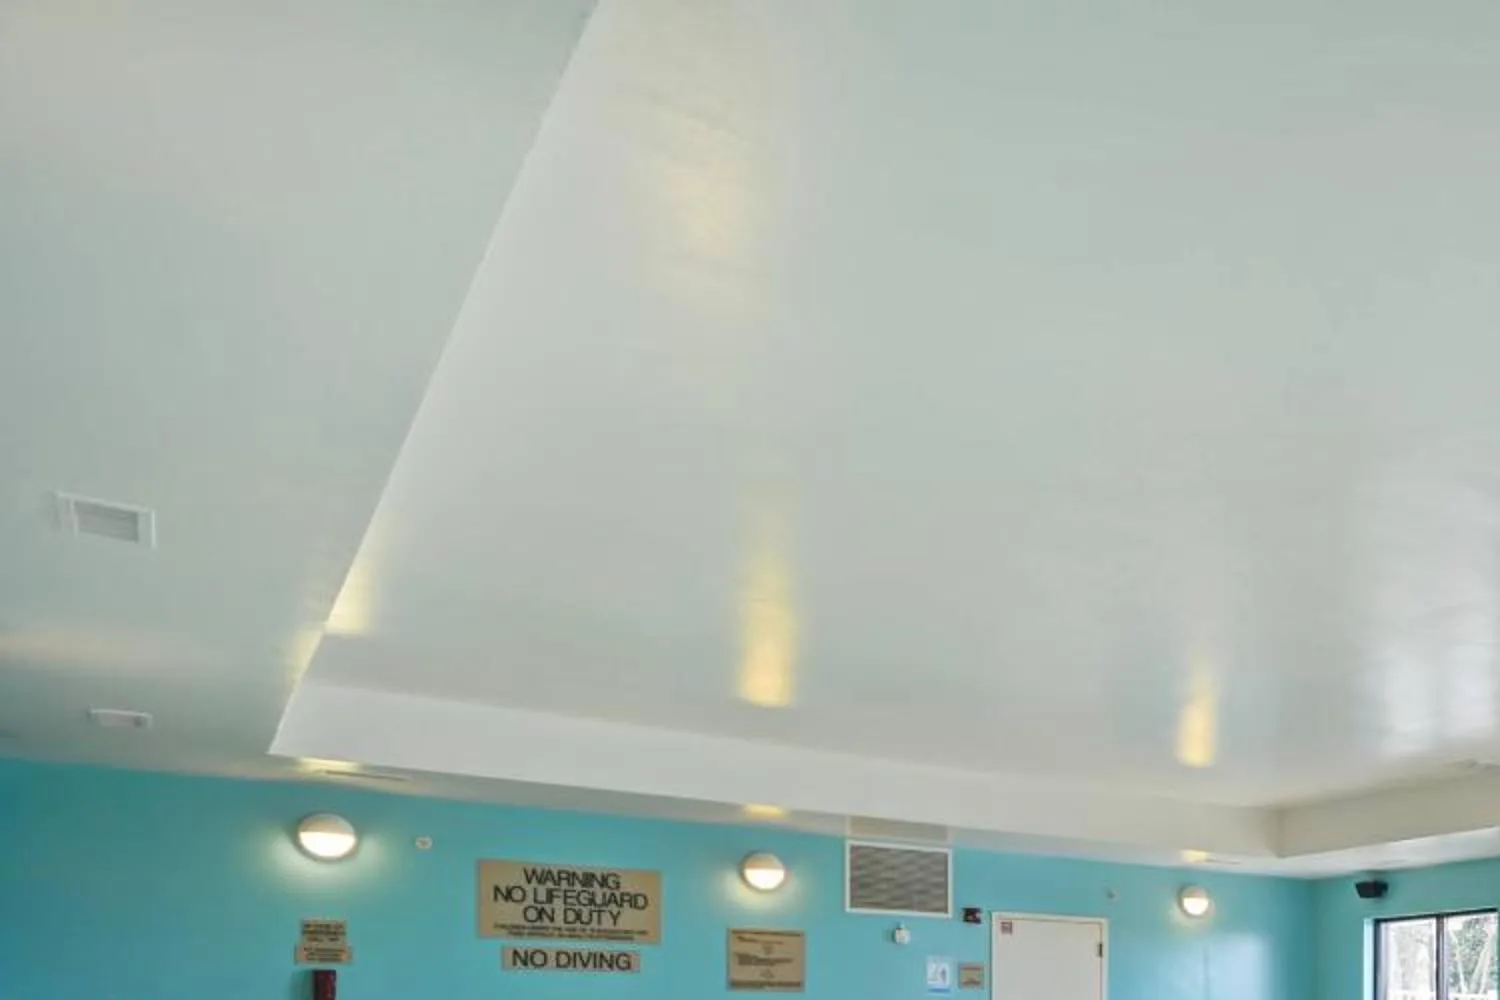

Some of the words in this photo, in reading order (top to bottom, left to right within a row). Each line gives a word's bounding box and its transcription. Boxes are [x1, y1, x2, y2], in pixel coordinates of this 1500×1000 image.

[523, 867, 621, 890] WARNING
[493, 885, 526, 903] NO
[533, 887, 648, 910] LIFEGUARD
[523, 905, 555, 923] ON
[563, 907, 622, 926] DUTY
[512, 949, 548, 968] NO
[555, 951, 632, 971] DIVING
